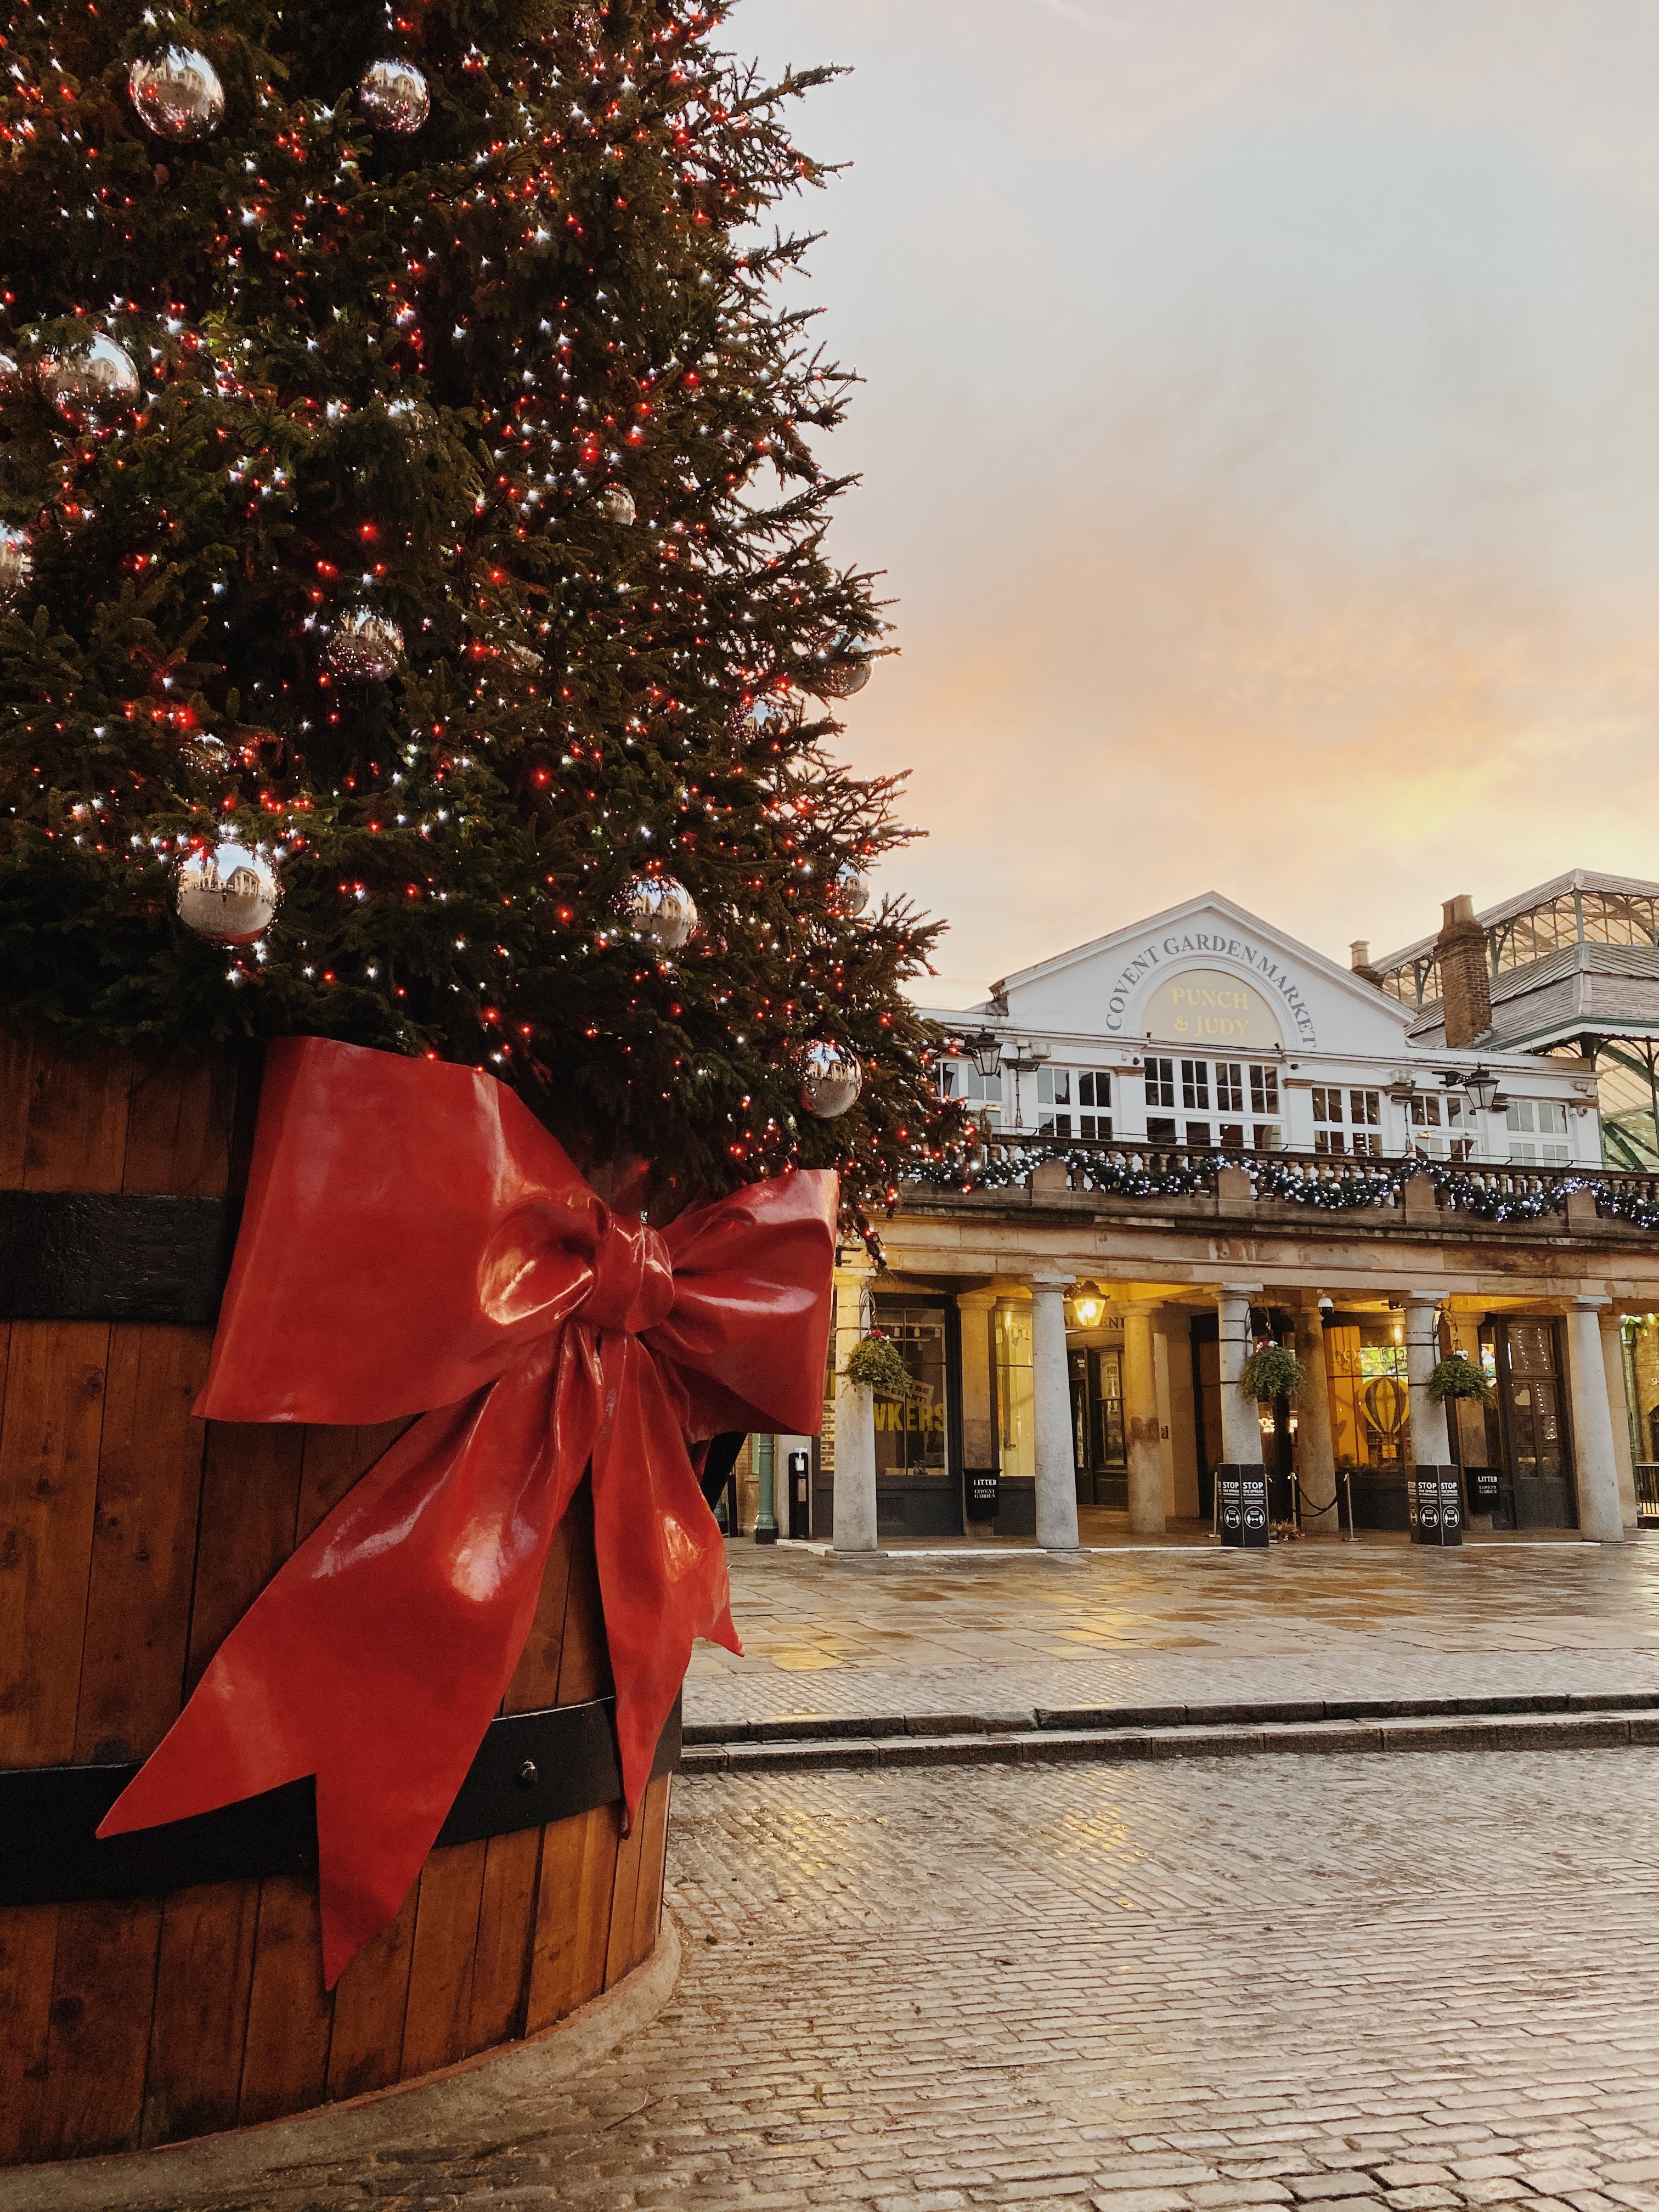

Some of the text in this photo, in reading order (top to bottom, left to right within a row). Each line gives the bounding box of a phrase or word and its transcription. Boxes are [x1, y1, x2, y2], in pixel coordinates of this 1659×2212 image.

[1106, 934, 1317, 1047] COVENT GARDEN MARKET
[1170, 987, 1249, 1009] PUNCH
[1173, 1015, 1250, 1037] & JUDY
